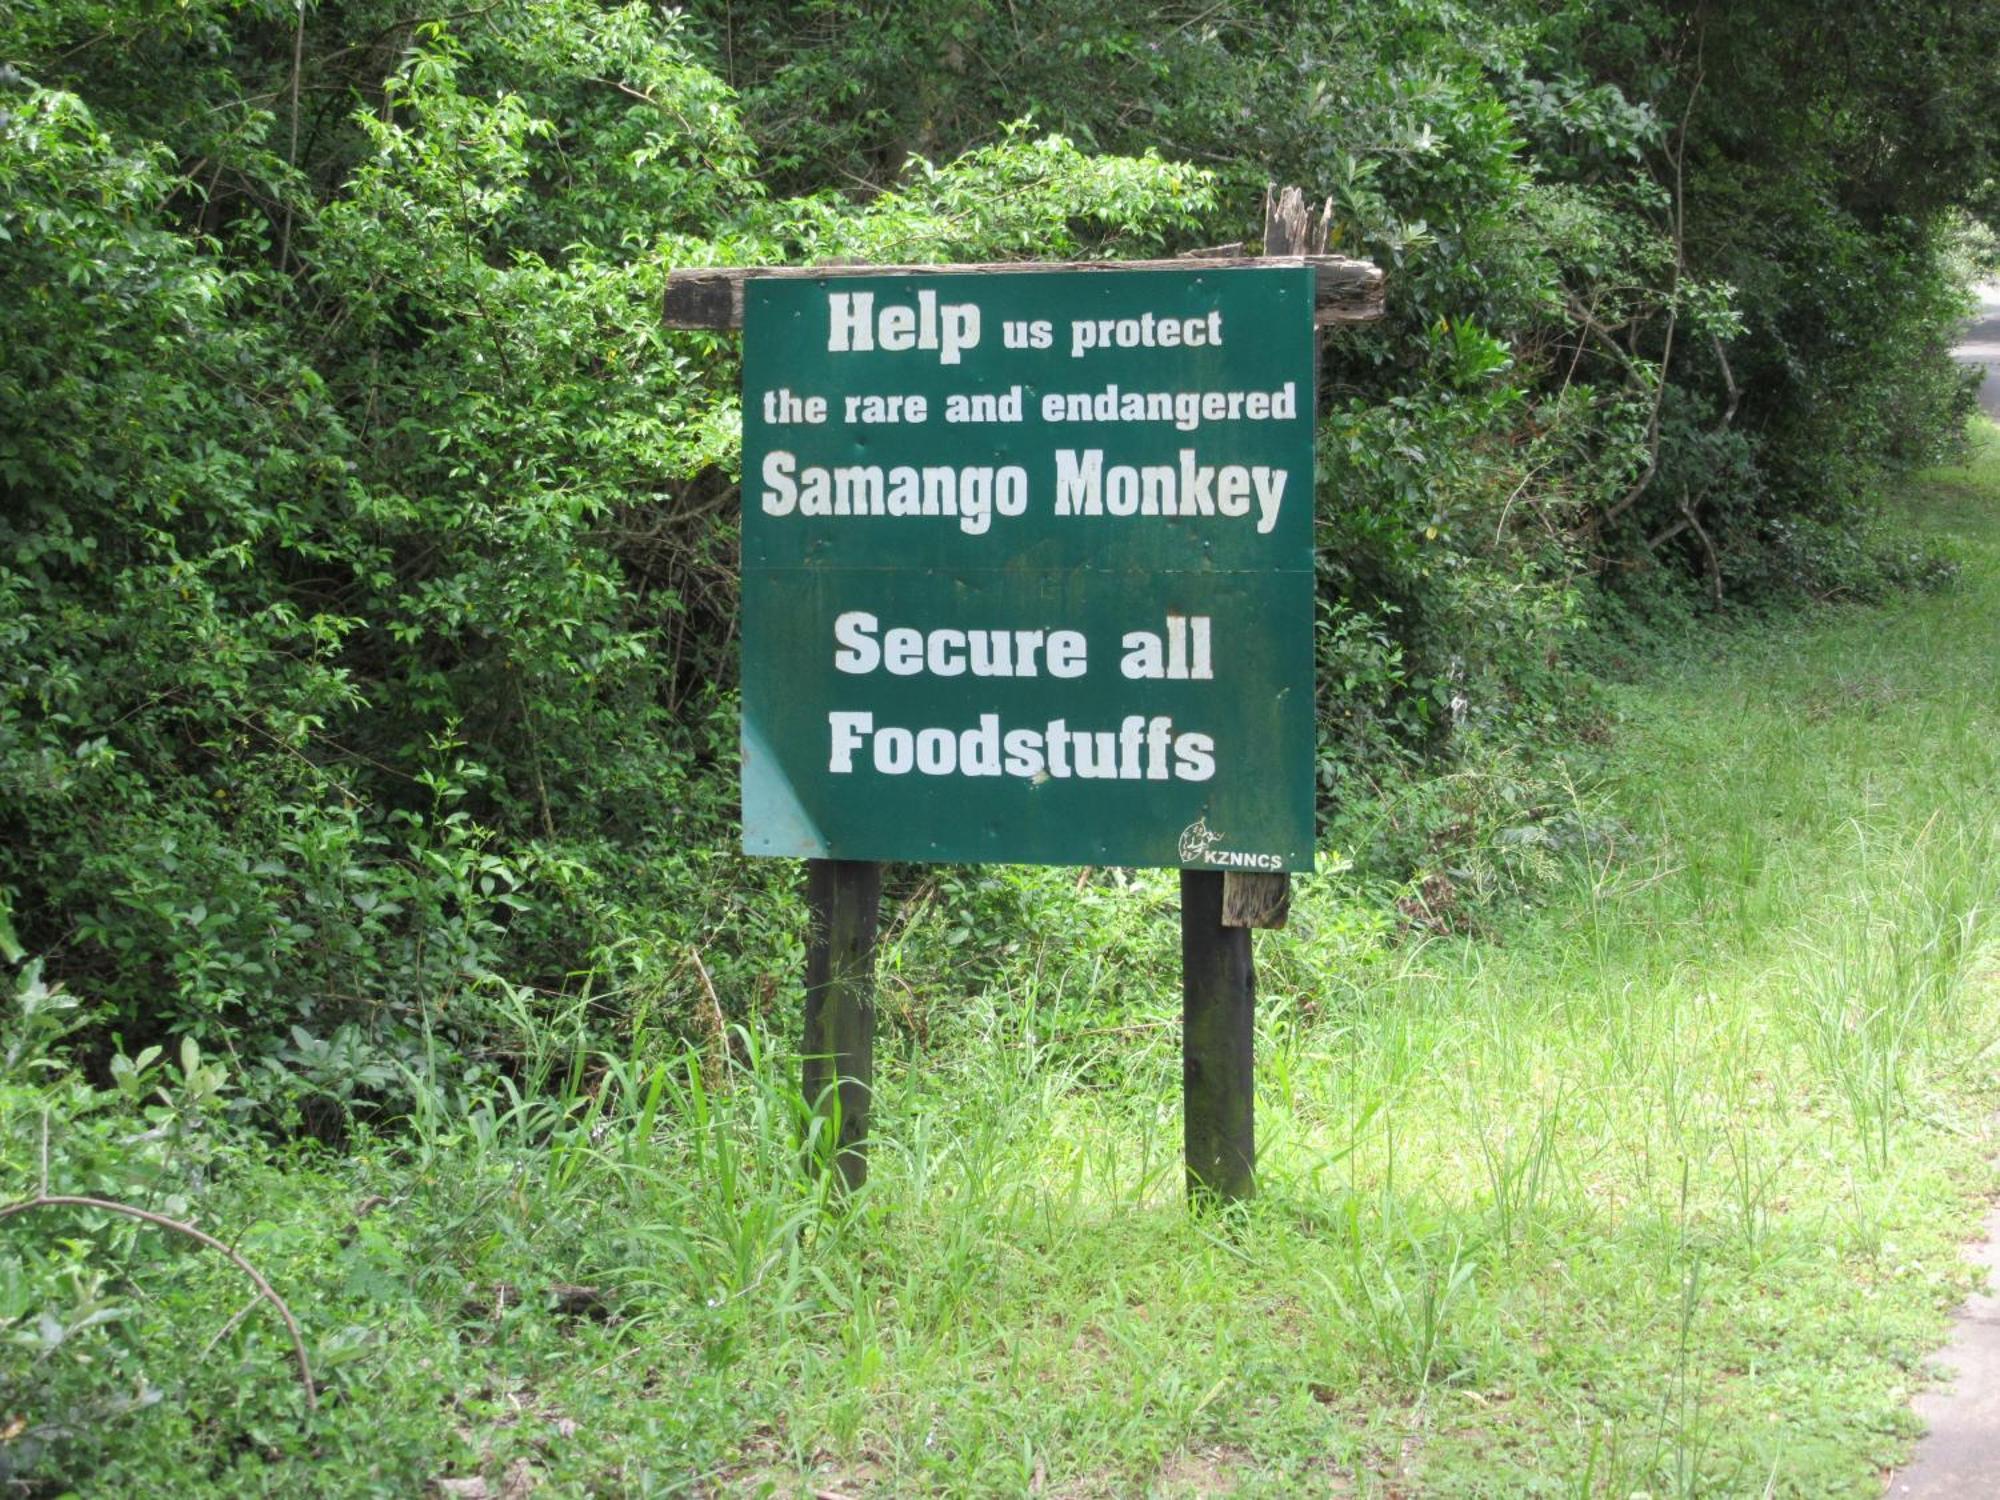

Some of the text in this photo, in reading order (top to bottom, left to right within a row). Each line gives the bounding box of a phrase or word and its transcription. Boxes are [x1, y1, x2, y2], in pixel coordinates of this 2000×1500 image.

[828, 290, 1222, 365] Help us protect
[763, 382, 1297, 431] the rare and endangered
[762, 449, 1288, 535] Samango Monkey
[834, 611, 1213, 680] Secure all
[828, 711, 1216, 782] Foodstuffs
[1204, 850, 1283, 871] KZNNCS
